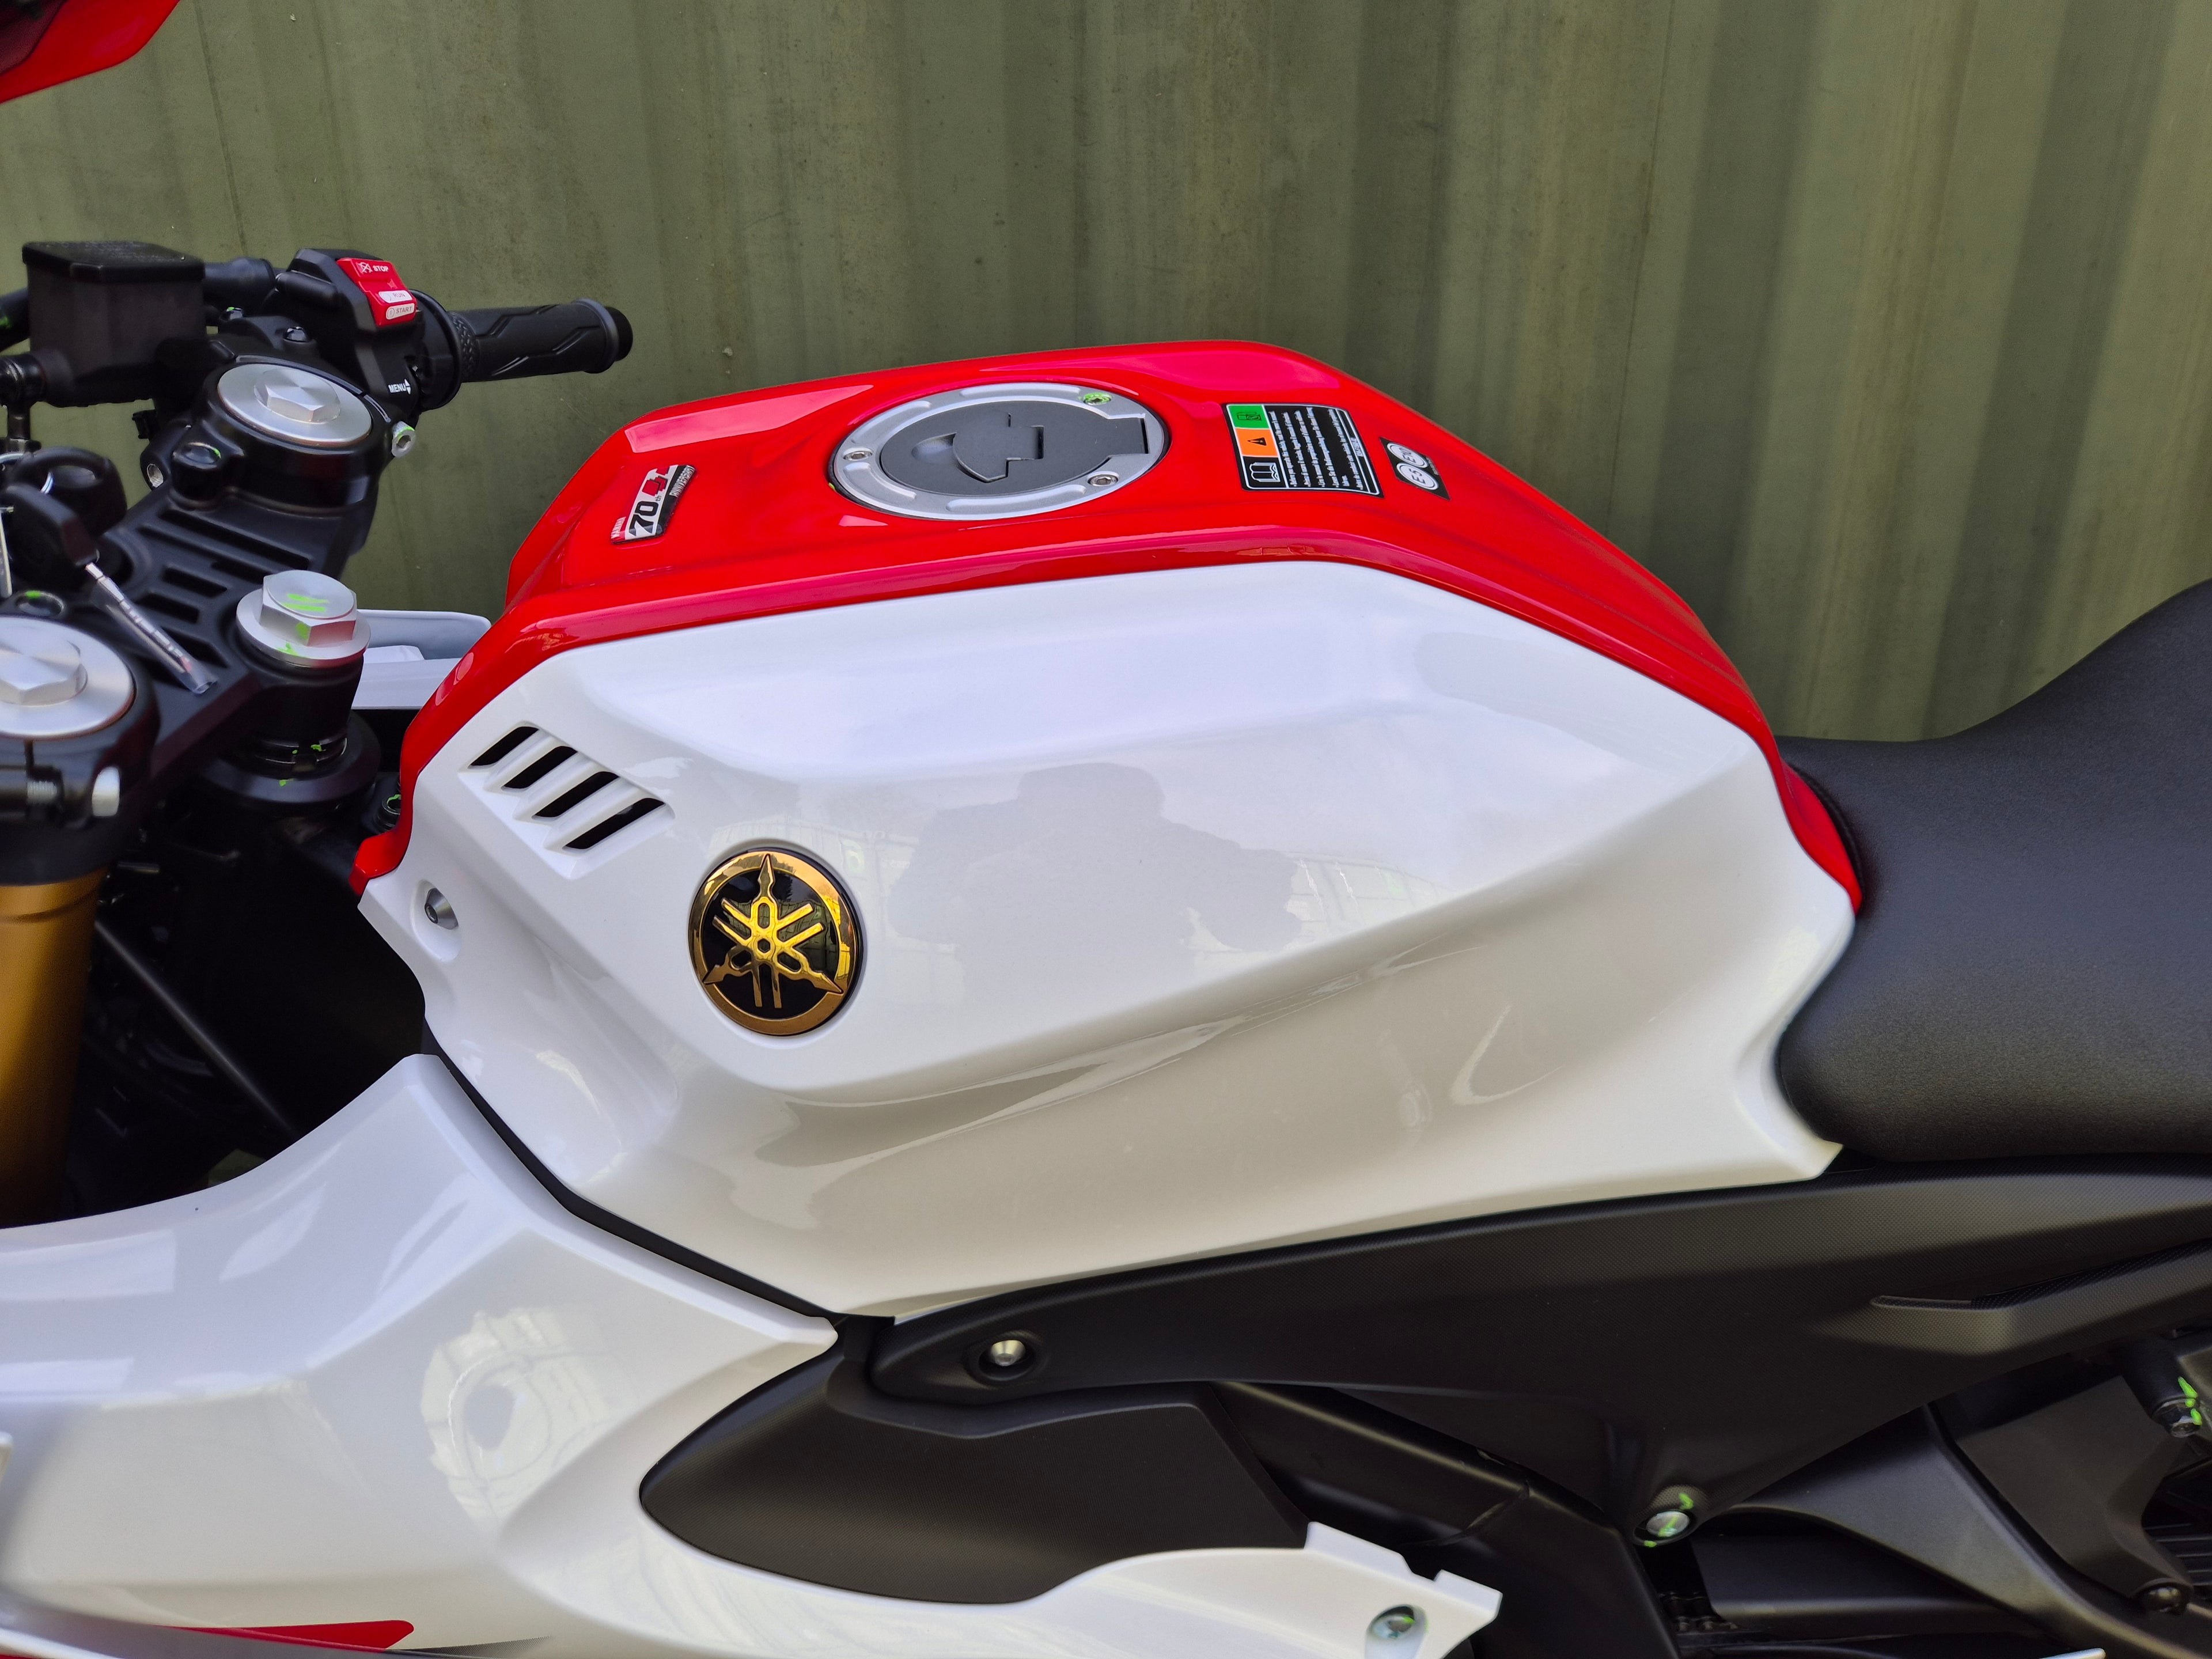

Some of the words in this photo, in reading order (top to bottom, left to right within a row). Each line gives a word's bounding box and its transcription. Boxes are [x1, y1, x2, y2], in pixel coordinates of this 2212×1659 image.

[396, 306, 412, 314] START
[388, 383, 407, 393] MENU
[1409, 469, 1426, 484] E5
